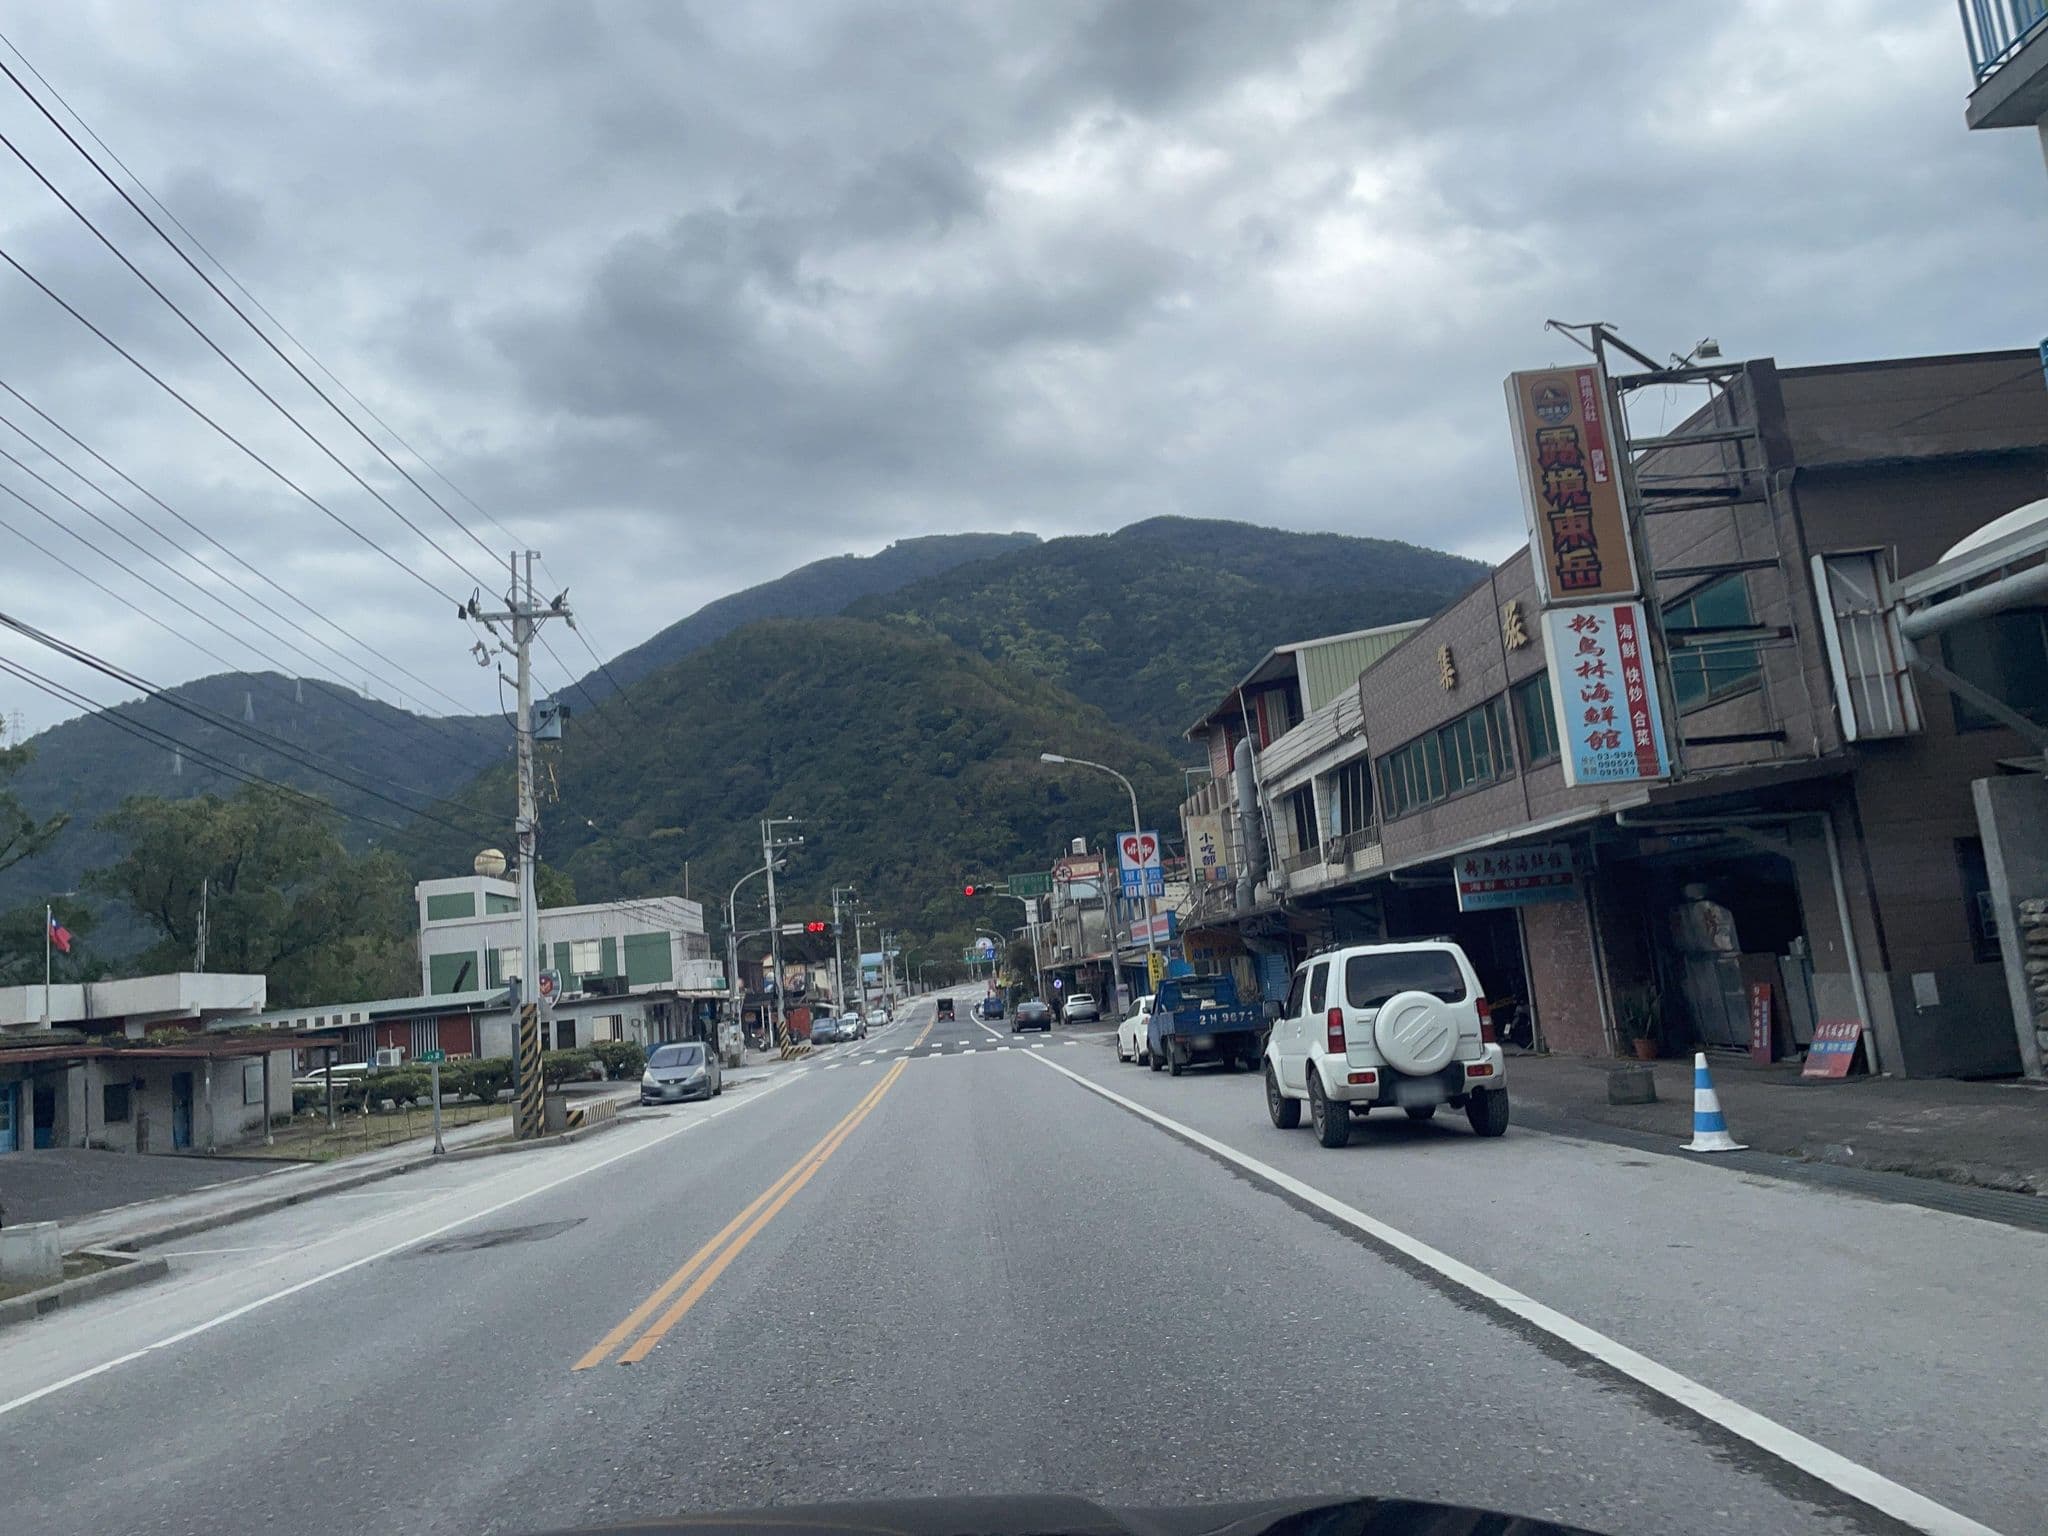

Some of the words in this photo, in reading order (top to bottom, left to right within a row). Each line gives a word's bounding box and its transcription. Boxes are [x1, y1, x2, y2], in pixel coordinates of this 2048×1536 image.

[1618, 623, 1636, 659] 海鮮
[1626, 666, 1643, 702] 快炒
[1632, 710, 1651, 747] 合菜
[1199, 832, 1216, 866] 小吃部
